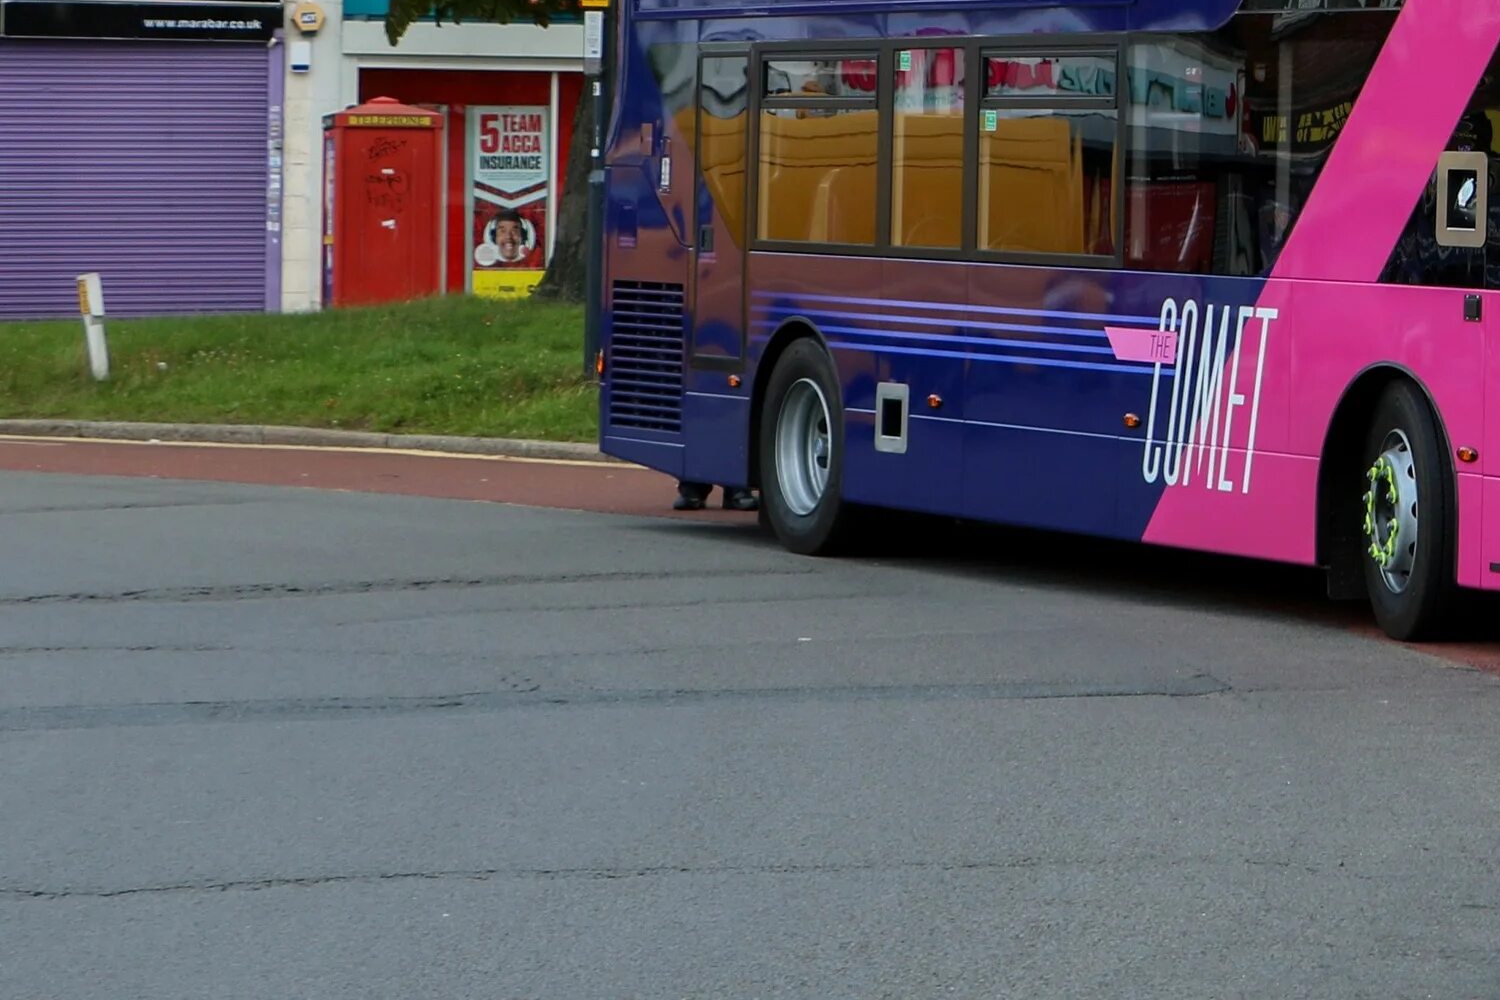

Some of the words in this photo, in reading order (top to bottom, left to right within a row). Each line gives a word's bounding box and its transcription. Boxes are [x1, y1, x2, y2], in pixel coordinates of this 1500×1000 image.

[143, 19, 262, 30] www.marabar.co.uk
[480, 114, 500, 153] 5
[502, 114, 542, 132] TEAM
[501, 135, 541, 153] ACCA
[480, 156, 542, 169] INSURANCE
[1151, 335, 1170, 358] THE
[1142, 297, 1278, 494] COMET
